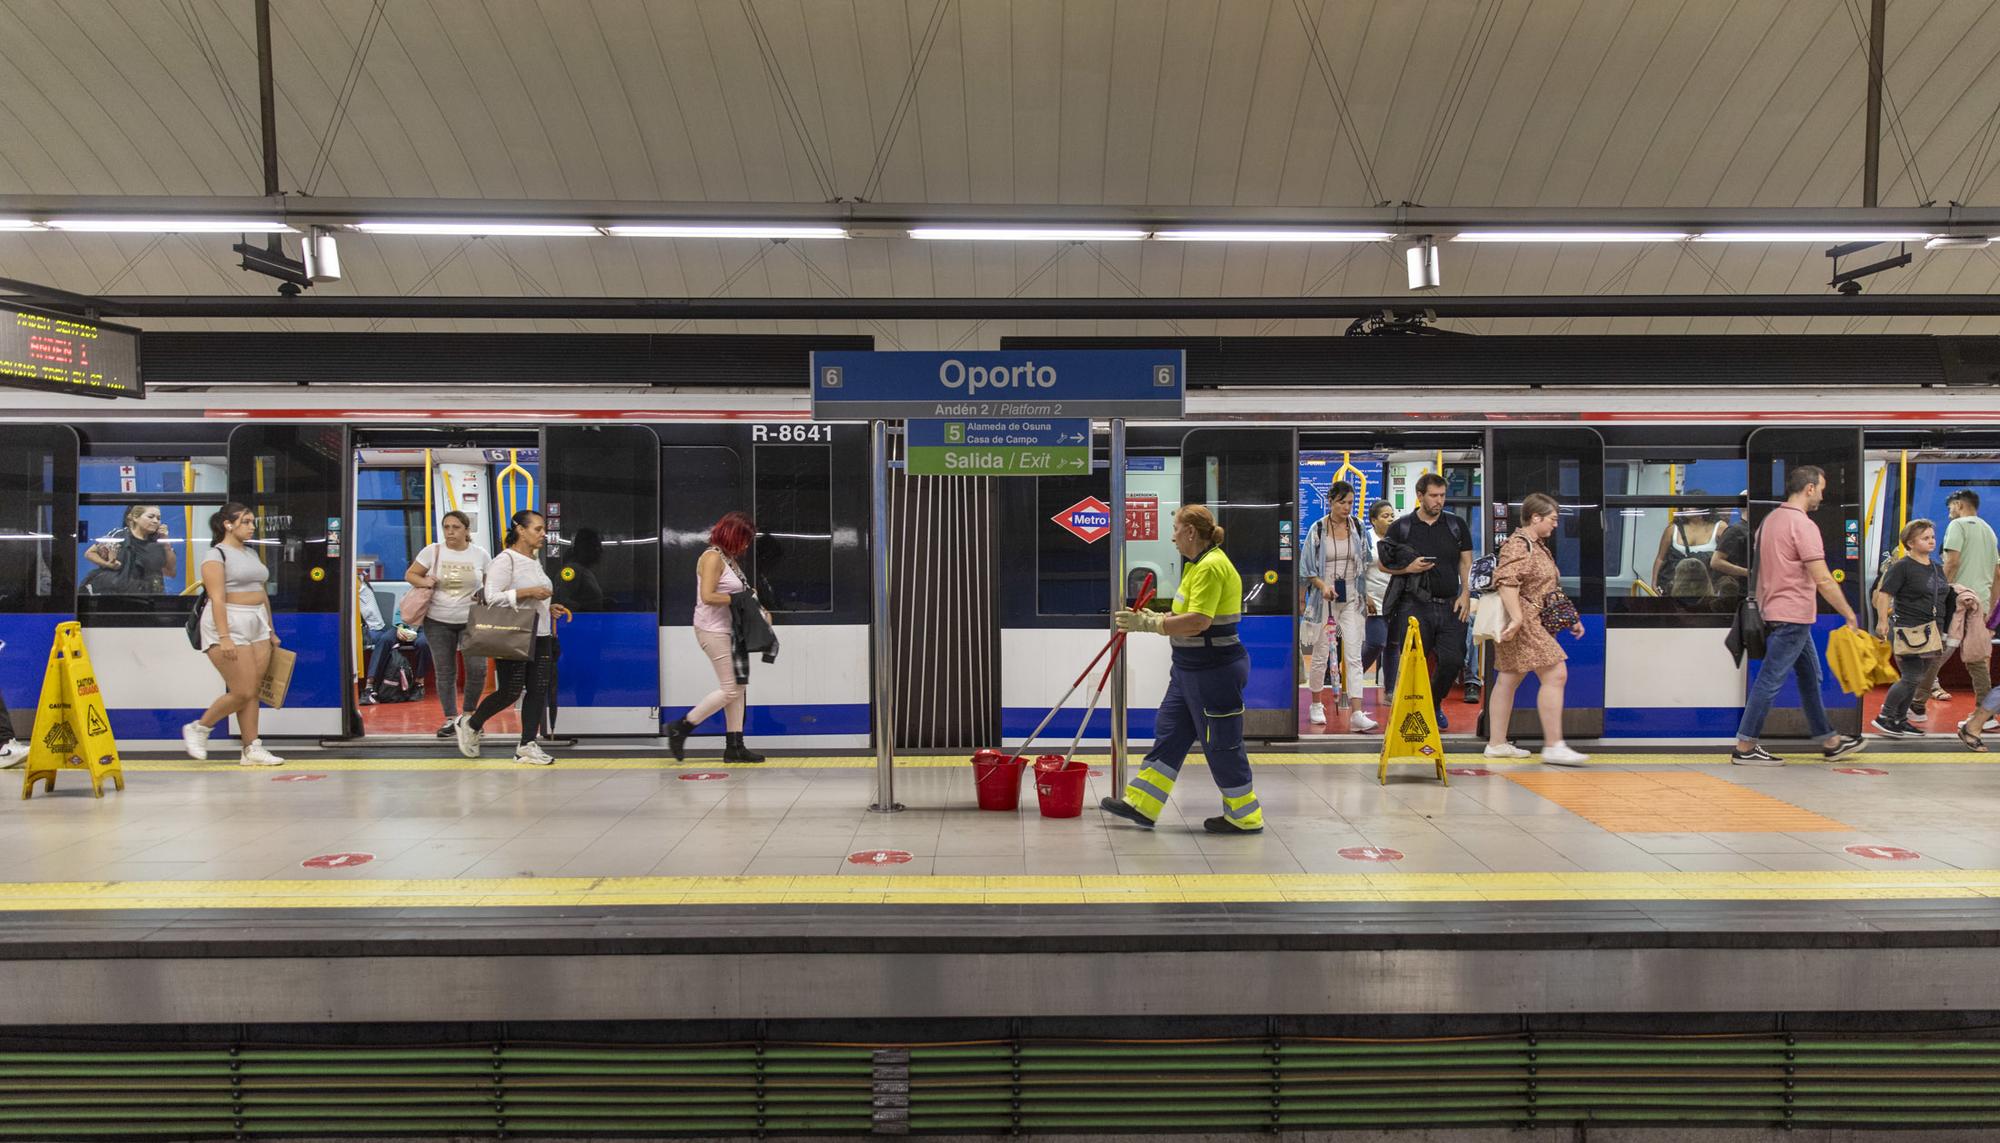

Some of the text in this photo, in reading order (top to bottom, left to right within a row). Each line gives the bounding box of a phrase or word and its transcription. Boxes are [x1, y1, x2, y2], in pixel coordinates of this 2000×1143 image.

[826, 369, 838, 385] 6
[940, 359, 1057, 395] Oporto
[1158, 367, 1170, 384] 6
[935, 403, 977, 416] Andén
[981, 404, 989, 415] 2
[1000, 403, 1051, 416] Platform
[1054, 403, 1063, 415] 2
[752, 425, 832, 442] R-8641
[949, 425, 960, 441] 5
[967, 422, 1052, 432] Alameda de Osuna
[967, 434, 1039, 446] Casa de Campo
[944, 452, 1004, 469] Salida
[1020, 452, 1051, 469] Exit
[1074, 514, 1107, 526] Metro
